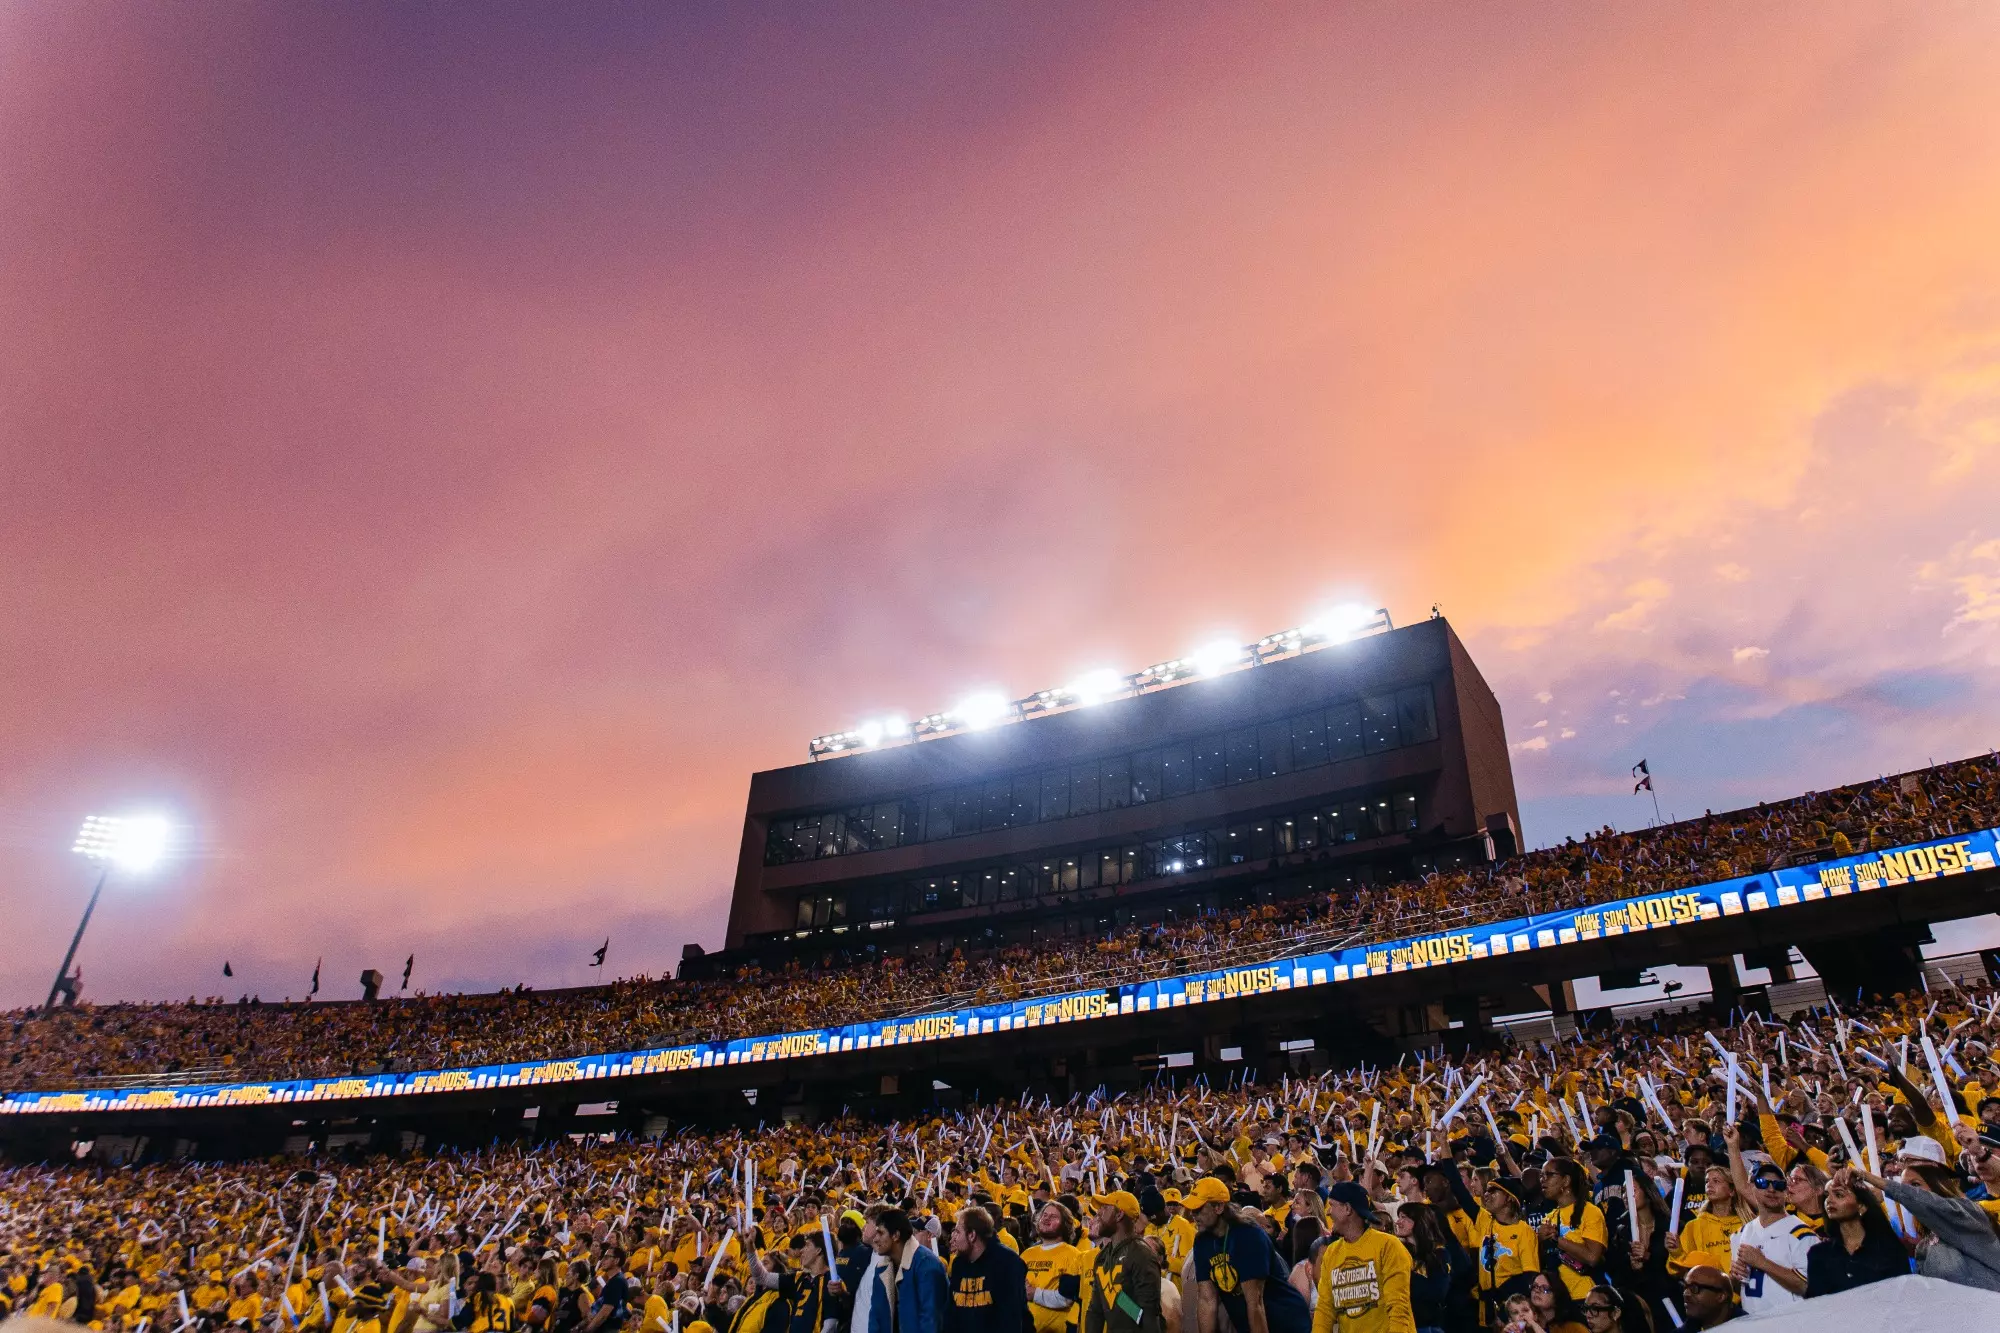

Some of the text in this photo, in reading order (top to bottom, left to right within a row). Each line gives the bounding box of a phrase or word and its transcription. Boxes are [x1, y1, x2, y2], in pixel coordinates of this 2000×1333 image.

[1819, 841, 1972, 888] MAKE SOME NOISE
[1574, 893, 1701, 932] MAKE SOME NOISE
[1366, 933, 1473, 968] MAKE SOME NOISE
[1185, 980, 1205, 997] MAKE
[1225, 966, 1279, 994] NOISE
[1061, 993, 1109, 1018] NOISE
[913, 1015, 958, 1037] NOISE
[781, 1034, 821, 1055] NOISE
[545, 1061, 580, 1079] NOISE
[659, 1049, 696, 1068] NOISE
[438, 1071, 472, 1088] NOISE
